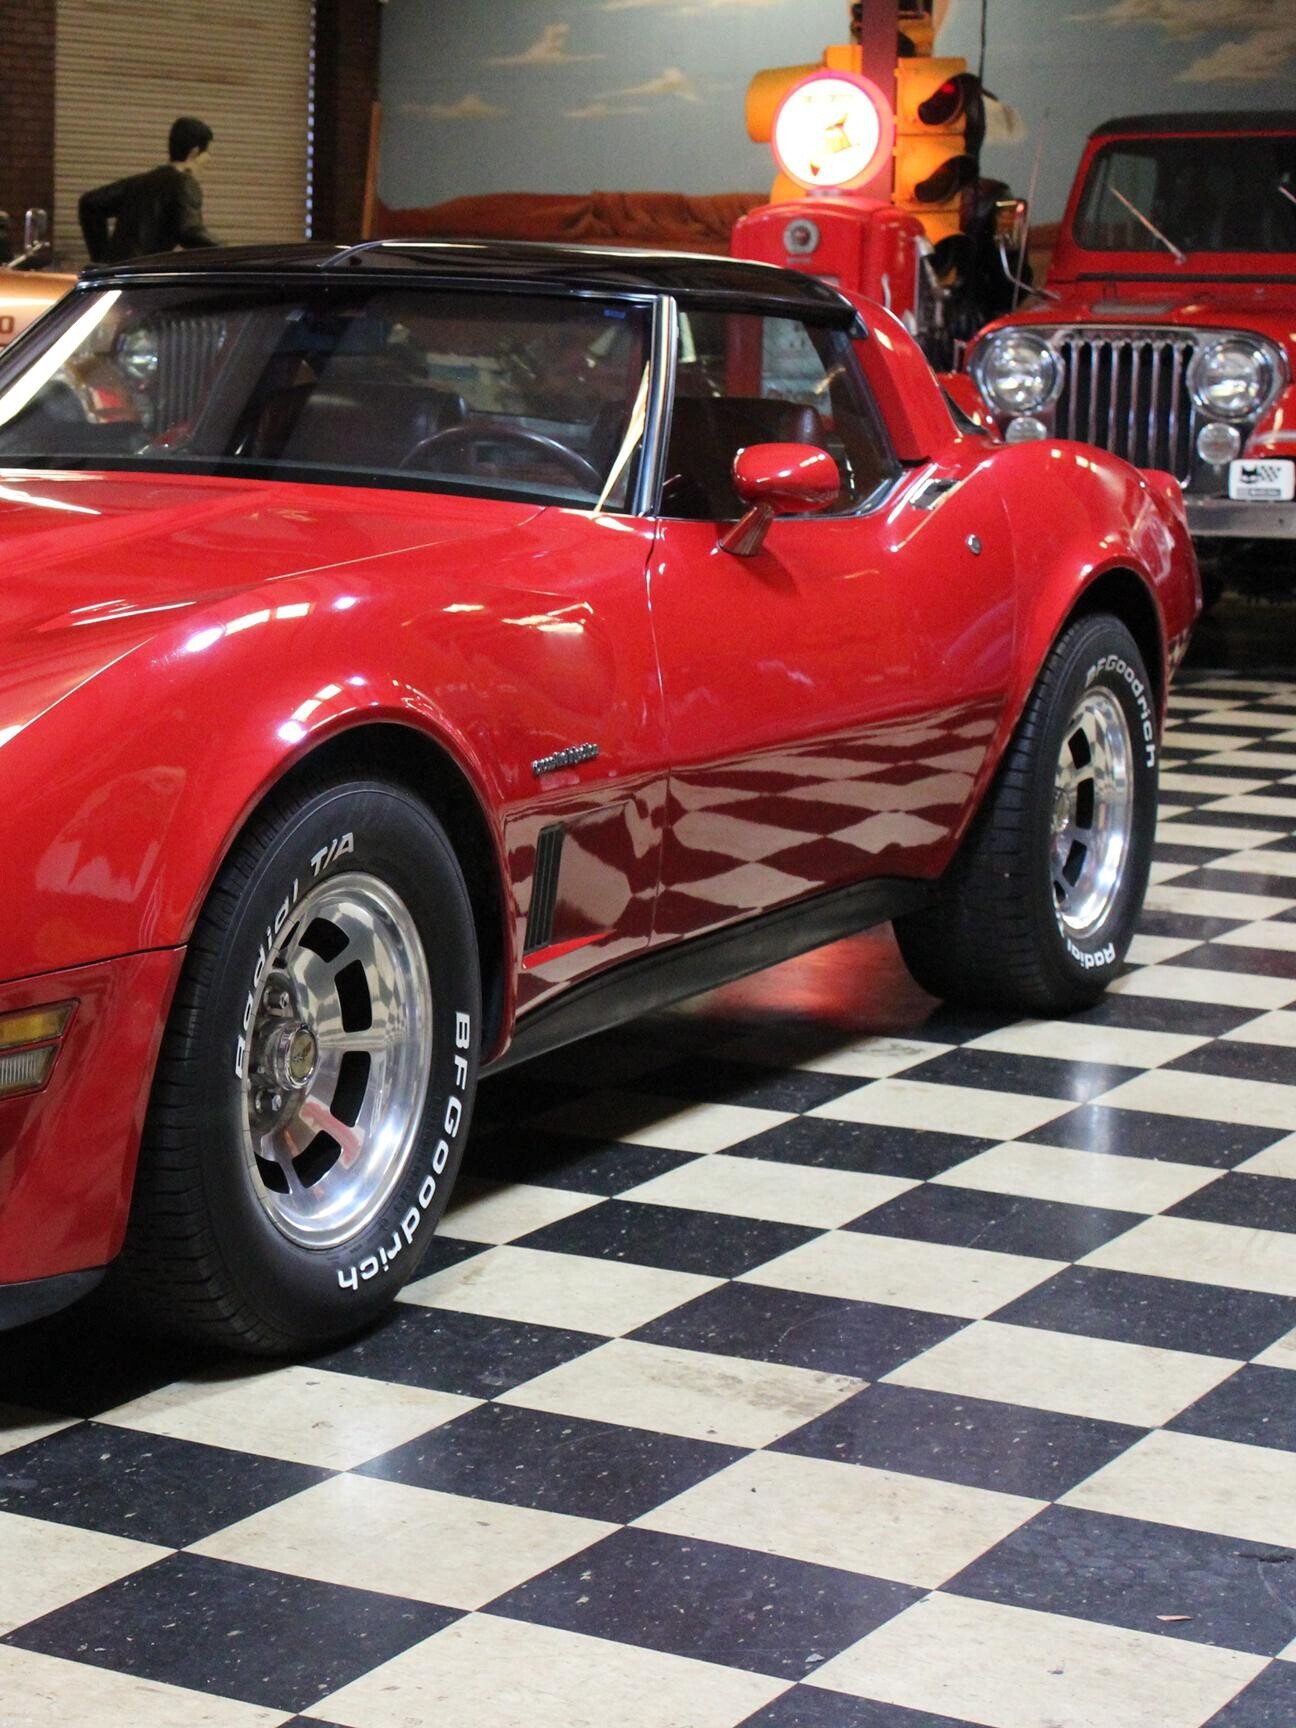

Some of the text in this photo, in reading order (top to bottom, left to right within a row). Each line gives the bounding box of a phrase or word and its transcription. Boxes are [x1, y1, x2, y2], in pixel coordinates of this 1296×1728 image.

[1085, 654, 1155, 768] BFGoodrich
[310, 832, 354, 877] T/A
[1067, 937, 1116, 969] Radial
[337, 1011, 471, 1290] BFGoodrich
